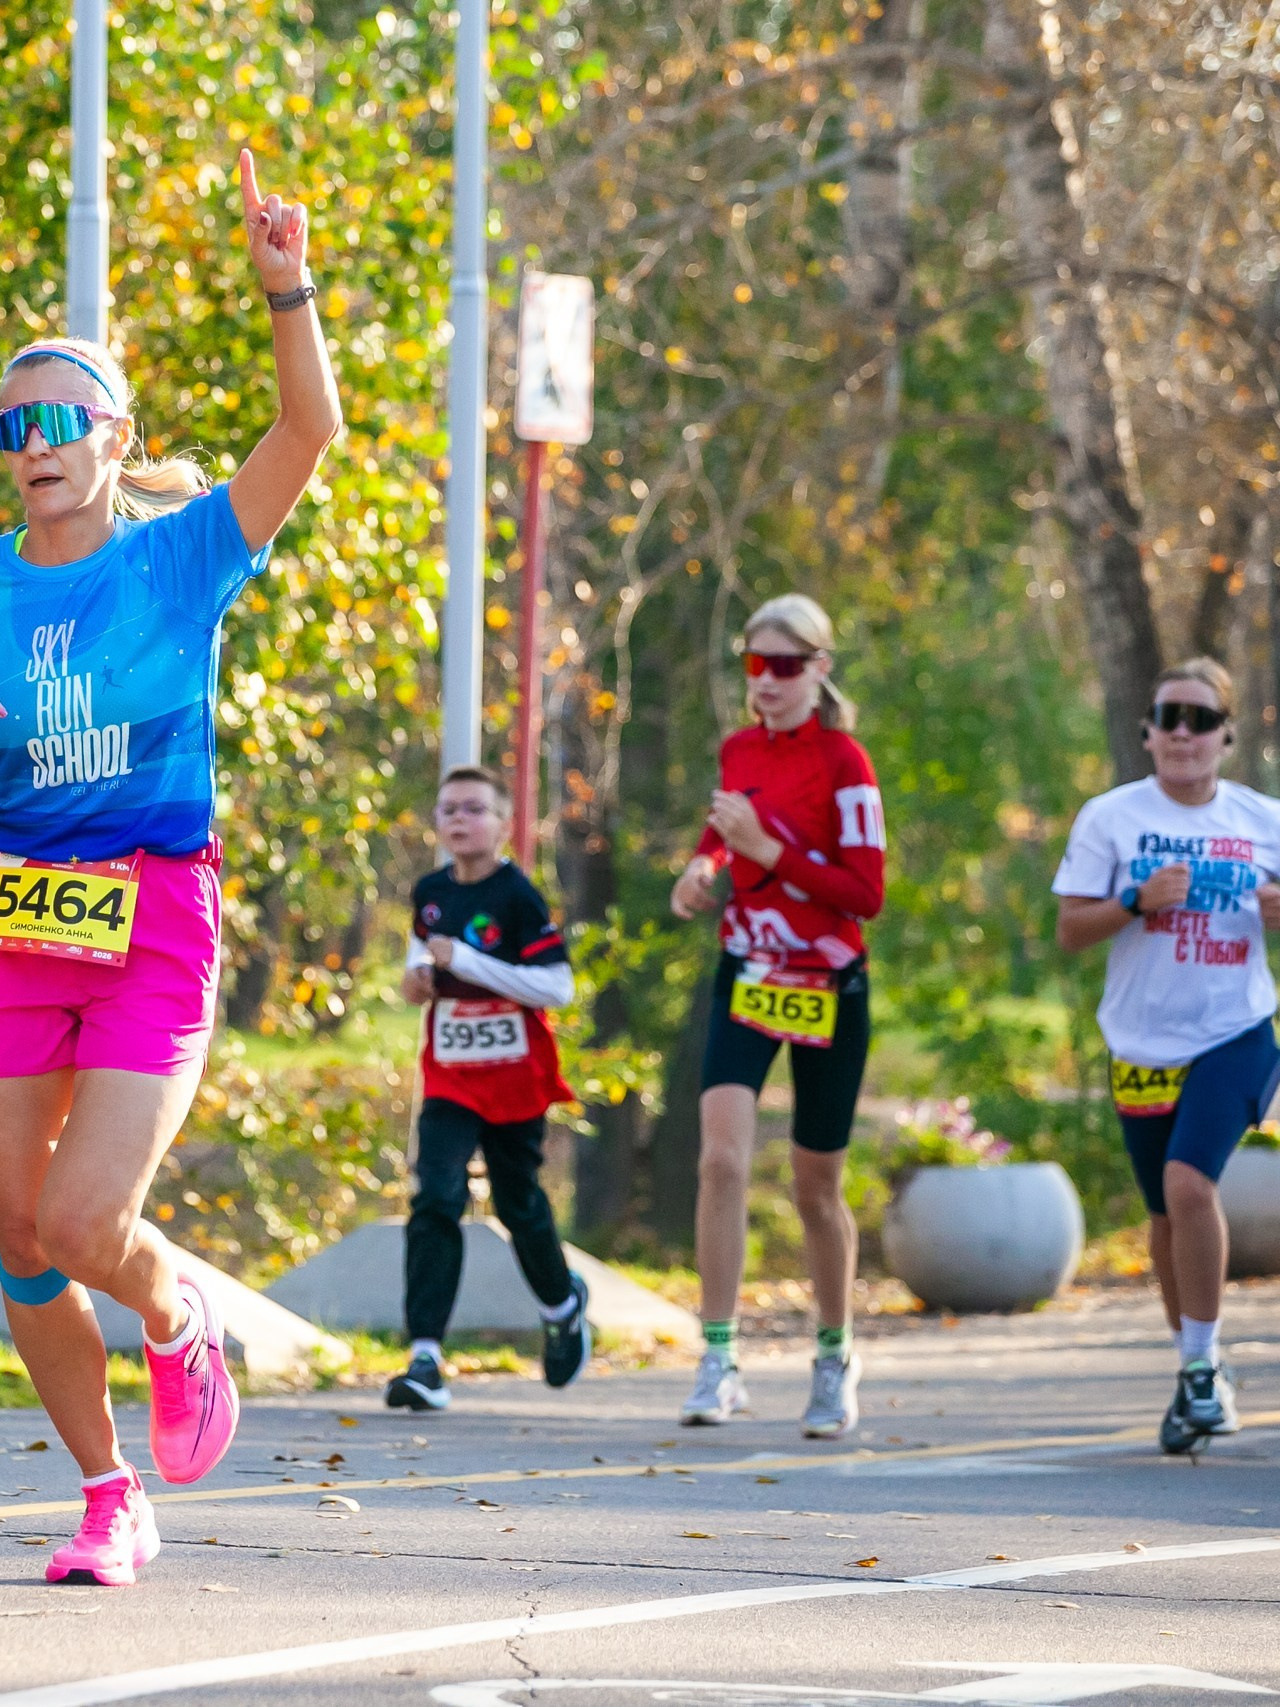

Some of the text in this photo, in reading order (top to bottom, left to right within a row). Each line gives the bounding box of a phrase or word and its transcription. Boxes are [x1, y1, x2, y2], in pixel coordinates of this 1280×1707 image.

[25, 619, 76, 682] SKY
[36, 672, 93, 736] RUN
[26, 721, 133, 789] SCHOOL
[110, 862, 117, 870] 5
[10, 922, 93, 940] СИМОНЕНКО АННА
[744, 988, 824, 1023] 5163
[441, 1019, 517, 1049] 5953
